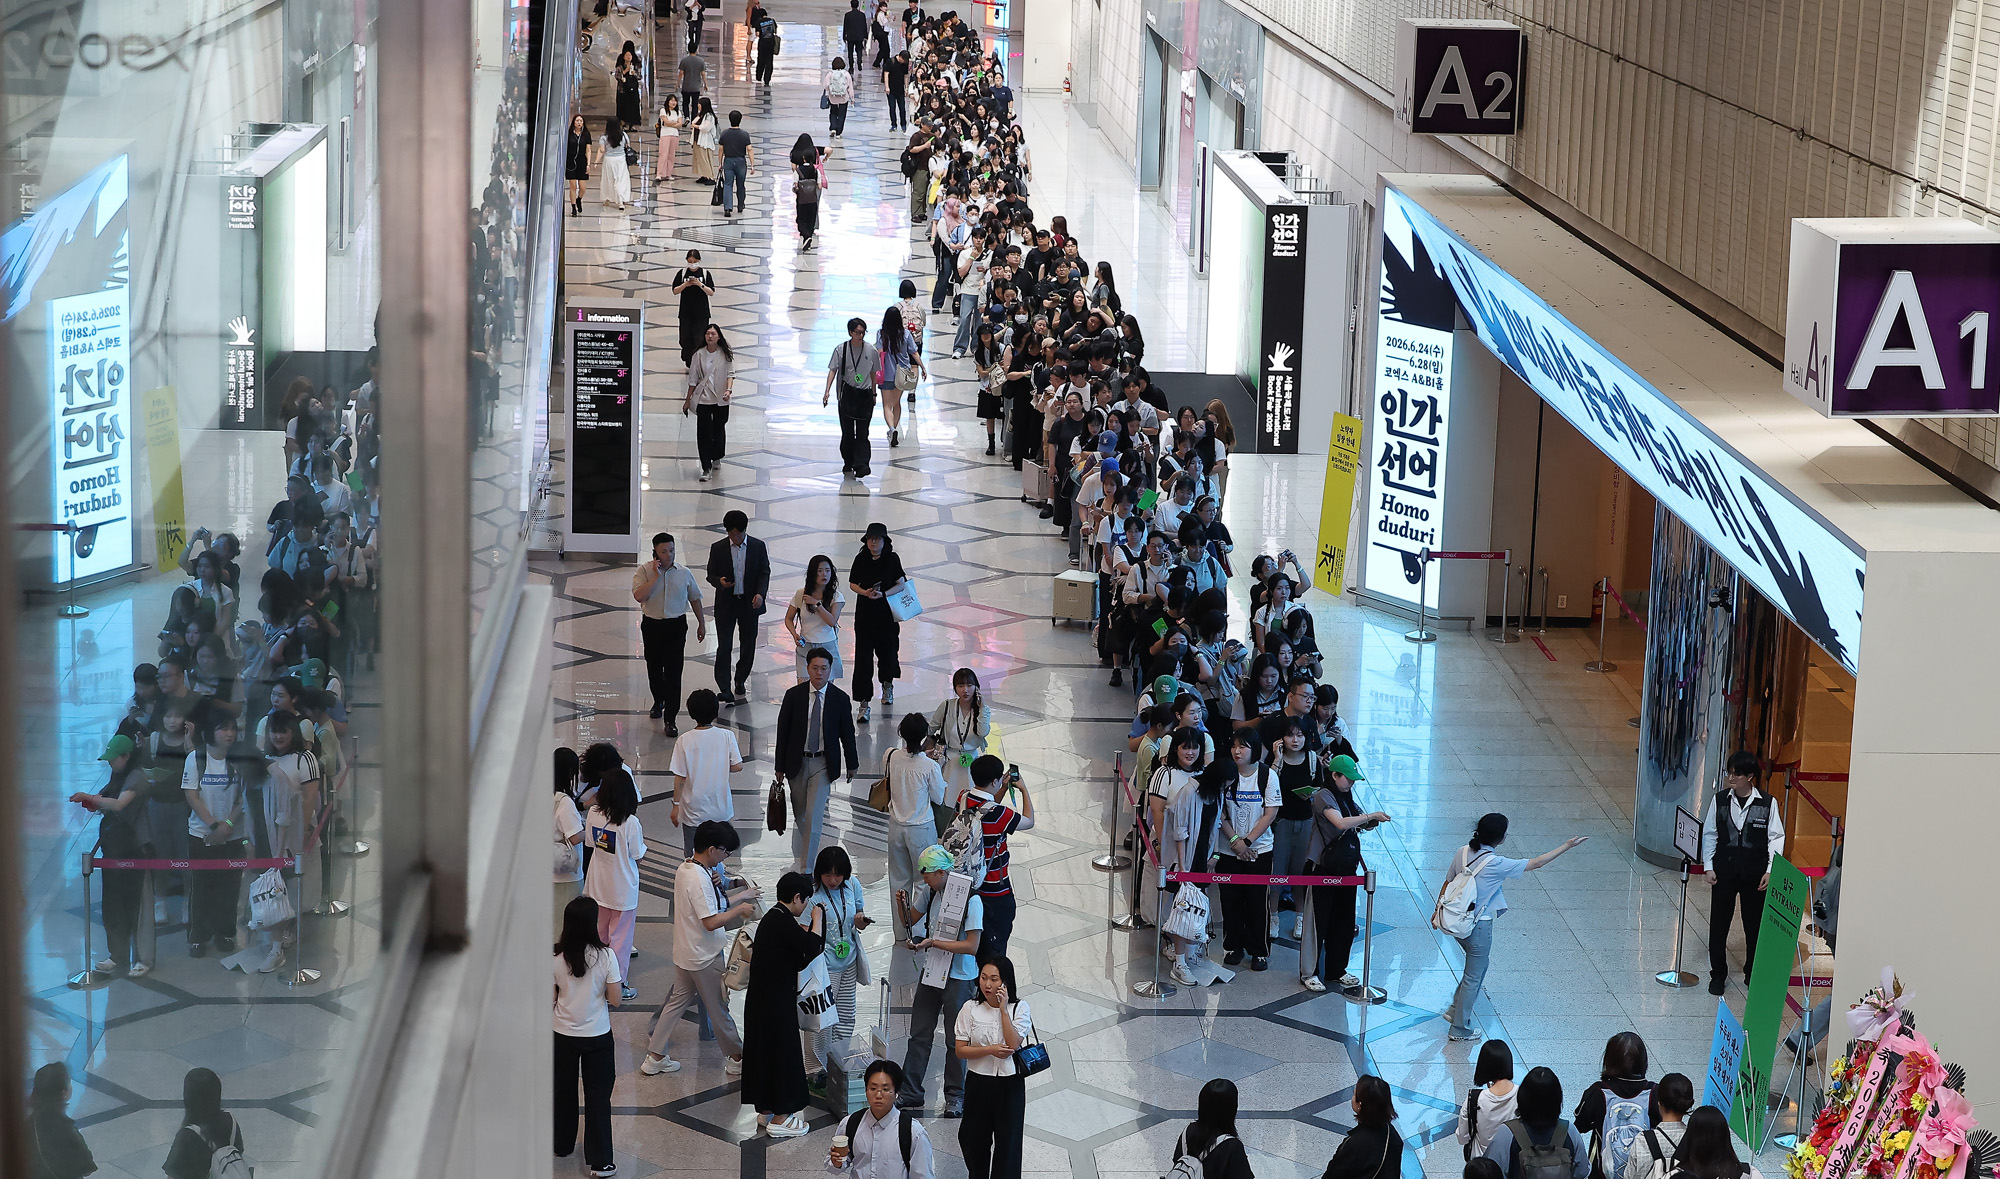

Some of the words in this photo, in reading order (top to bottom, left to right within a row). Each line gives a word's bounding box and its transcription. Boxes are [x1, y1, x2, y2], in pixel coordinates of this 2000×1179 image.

[1419, 45, 1513, 119] A2
[588, 314, 630, 322] information
[1844, 269, 1989, 390] A1
[1386, 336, 1444, 359] 2026.6.24(수)
[1790, 361, 1804, 388] Hall
[1804, 321, 1828, 402] A1
[617, 369, 628, 377] 3F
[1384, 367, 1409, 381] 코엑스
[1267, 375, 1276, 396] Book
[1275, 375, 1284, 398] Seoul
[616, 396, 627, 404] 2F
[1266, 396, 1275, 412] Fair
[1273, 398, 1283, 447] International
[1380, 493, 1429, 522] Homo
[1378, 515, 1435, 545] duduri
[1212, 874, 1232, 882] coex
[1269, 876, 1289, 884] coex
[1323, 877, 1343, 885] coex
[1771, 886, 1800, 918] ENTRANCE
